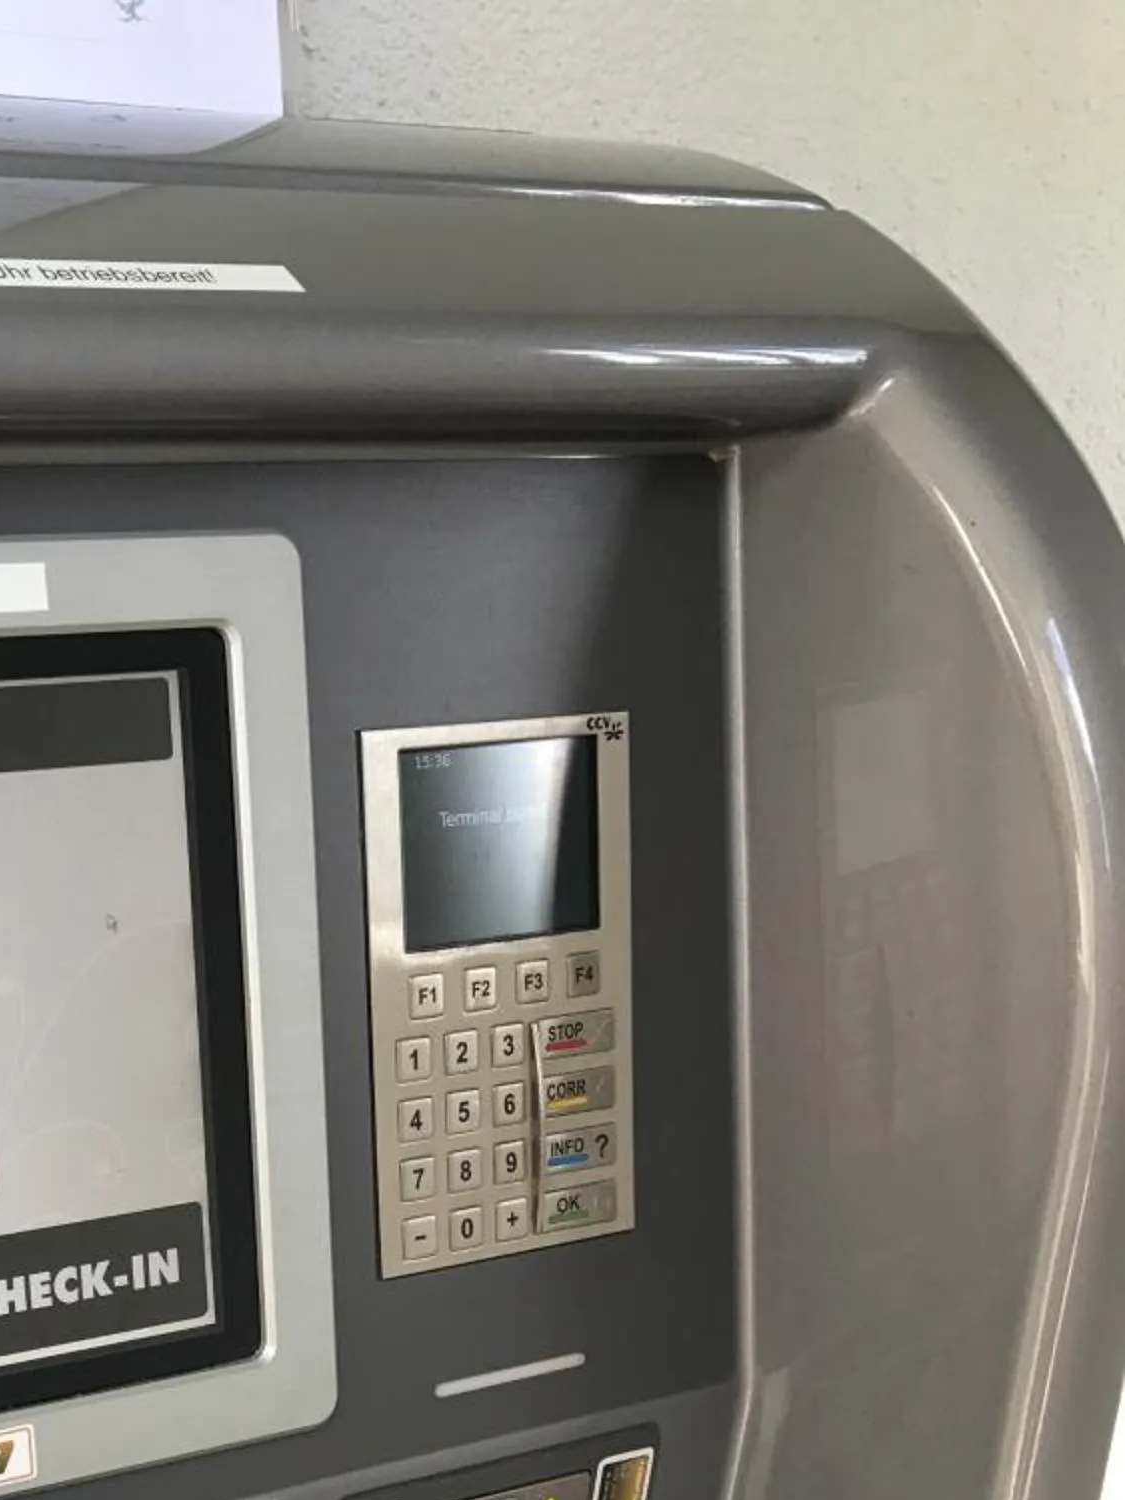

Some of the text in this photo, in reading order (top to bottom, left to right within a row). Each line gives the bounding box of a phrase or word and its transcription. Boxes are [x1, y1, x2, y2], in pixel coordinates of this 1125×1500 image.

[37, 265, 217, 284] betriebsbereit!
[418, 964, 594, 1005] F1 F2 F3 F4
[548, 1022, 584, 1041] STOP
[409, 1035, 514, 1070] 1 2 3
[547, 1079, 586, 1100] CORR
[410, 1094, 516, 1131] 4 5 6
[550, 1134, 609, 1157] INFO ?
[413, 1151, 517, 1190] 7 8 9
[556, 1194, 579, 1214] OK
[461, 1218, 473, 1239] 0
